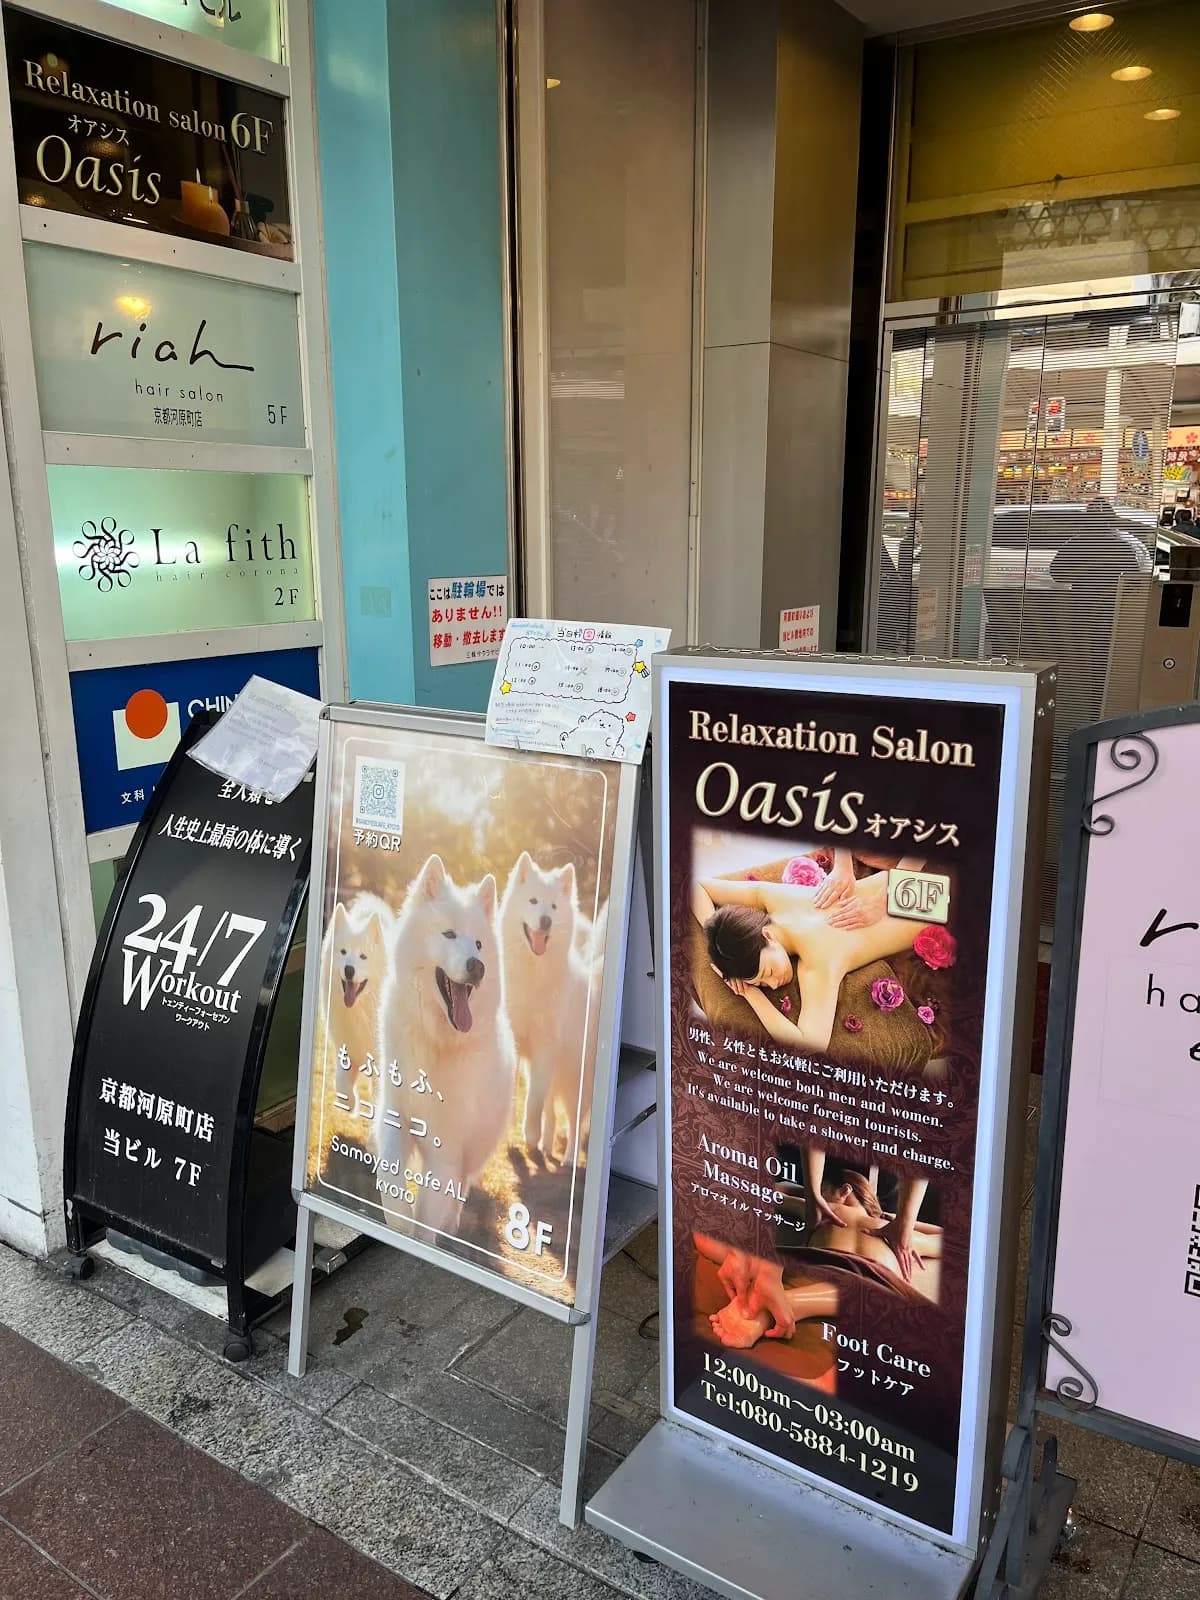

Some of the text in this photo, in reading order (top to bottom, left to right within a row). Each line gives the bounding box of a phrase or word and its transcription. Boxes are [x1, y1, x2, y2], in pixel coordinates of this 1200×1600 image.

[24, 60, 273, 155] Relaxation salon 6F
[68, 115, 130, 146] オアシス
[36, 134, 161, 205] Oasis
[91, 320, 254, 372] riah
[135, 379, 224, 403] hair salon
[267, 404, 287, 425] 5F
[153, 407, 203, 428] 京都河原町店
[150, 523, 298, 565] La fith
[156, 567, 298, 583] hair corona
[274, 587, 299, 606] 2F
[430, 580, 504, 600] ここは駐輪場では
[688, 710, 976, 767] Relaxation Salon
[120, 785, 156, 805] 文科
[696, 761, 864, 834] Oasis
[158, 813, 302, 862] 人生史上最高の体に導く
[354, 830, 401, 852] 予約QR
[864, 813, 960, 848] オアシス
[894, 877, 944, 912] 6F
[123, 893, 267, 987] 24/7
[122, 948, 242, 1013] Workout
[176, 1013, 210, 1031] ワークアウト
[338, 1044, 444, 1102] もふもふ、
[688, 1026, 954, 1108] 男性、女性ともお気軽にご利用いただけます。
[698, 1050, 944, 1128] We are welcome both men and women.
[99, 1077, 215, 1142] 京都河原町店
[334, 1092, 441, 1147] ニコニコ。
[688, 1083, 955, 1172] It's available to take a shower and charge.
[713, 1073, 922, 1144] We are welcome foreign tourists.
[103, 1128, 202, 1186] 当ビル 7F
[331, 1135, 467, 1203] Samoyed cafe AL
[698, 1132, 798, 1184] Aroma Oil
[702, 1160, 784, 1205] Massage
[376, 1179, 414, 1204] KYOTO
[691, 1182, 806, 1232] アロマオイル マッサージ
[504, 1202, 554, 1256] 8F
[822, 1322, 932, 1378] Foot Care
[837, 1358, 915, 1396] フットケア
[701, 1380, 920, 1493] Tel:080-5884-1219
